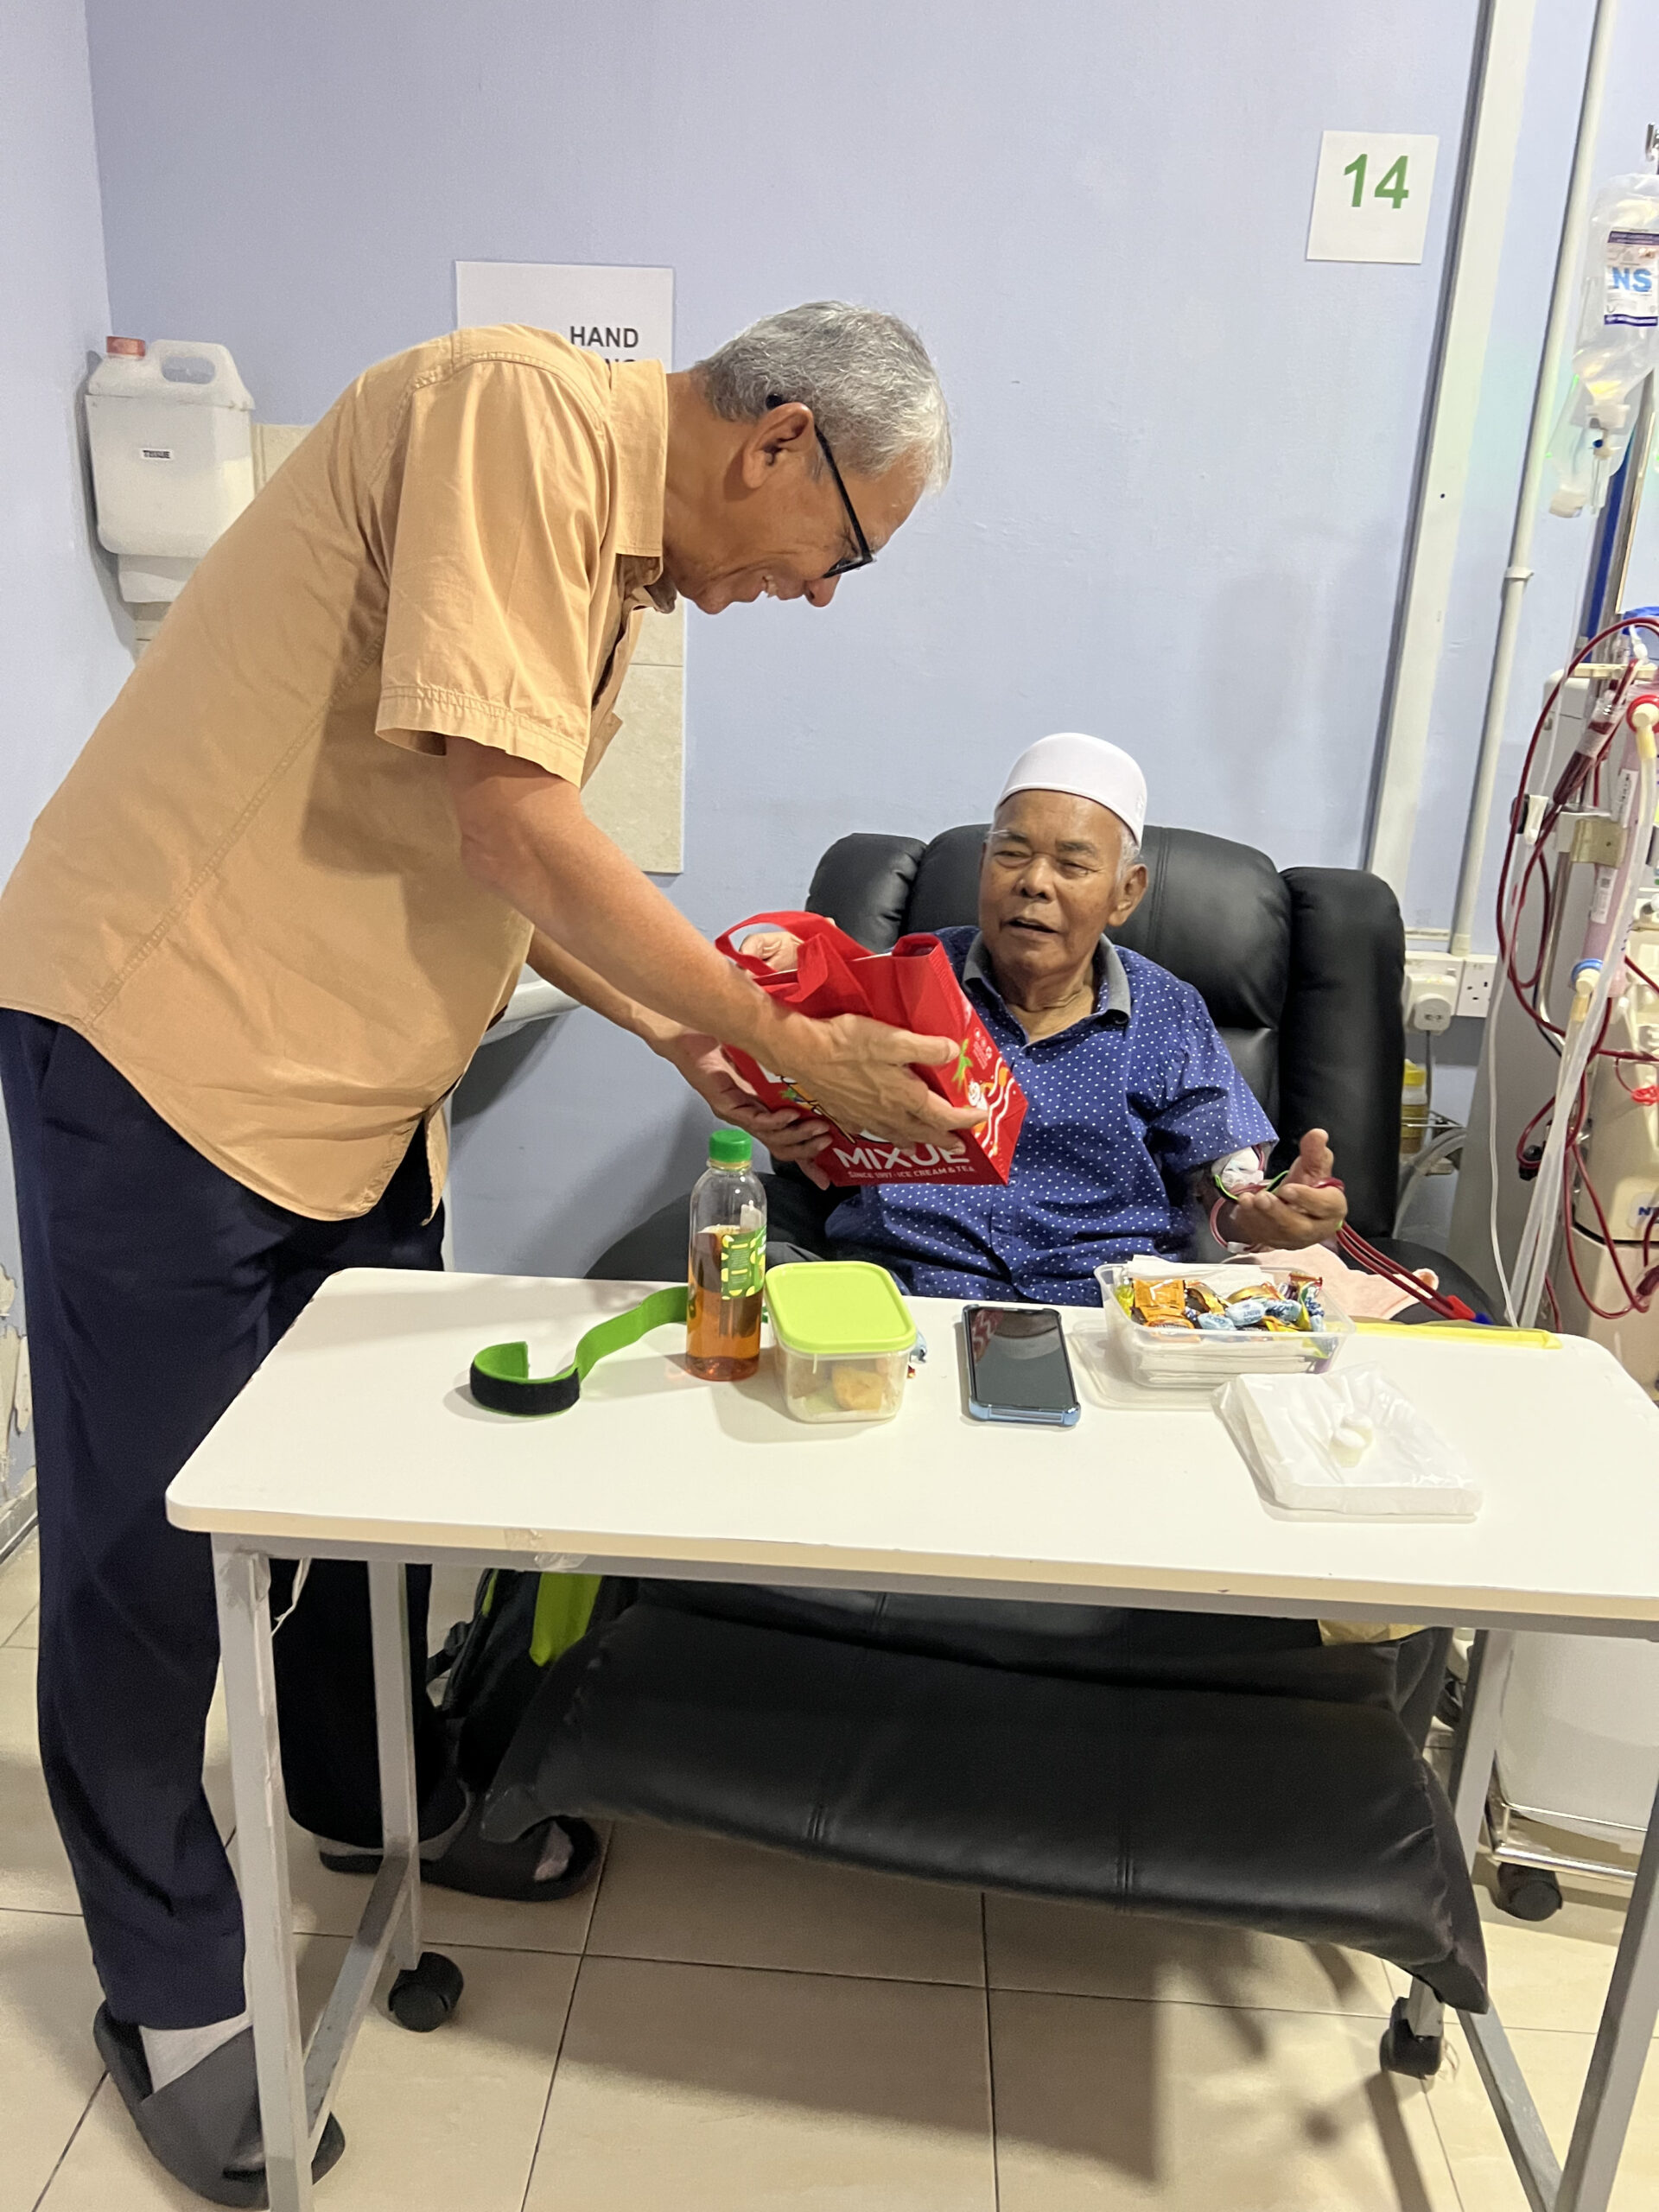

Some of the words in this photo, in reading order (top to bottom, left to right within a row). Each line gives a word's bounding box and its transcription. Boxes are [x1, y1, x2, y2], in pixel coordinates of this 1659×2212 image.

[1344, 154, 1408, 208] 14
[1611, 266, 1652, 292] NS
[570, 326, 639, 347] HAND
